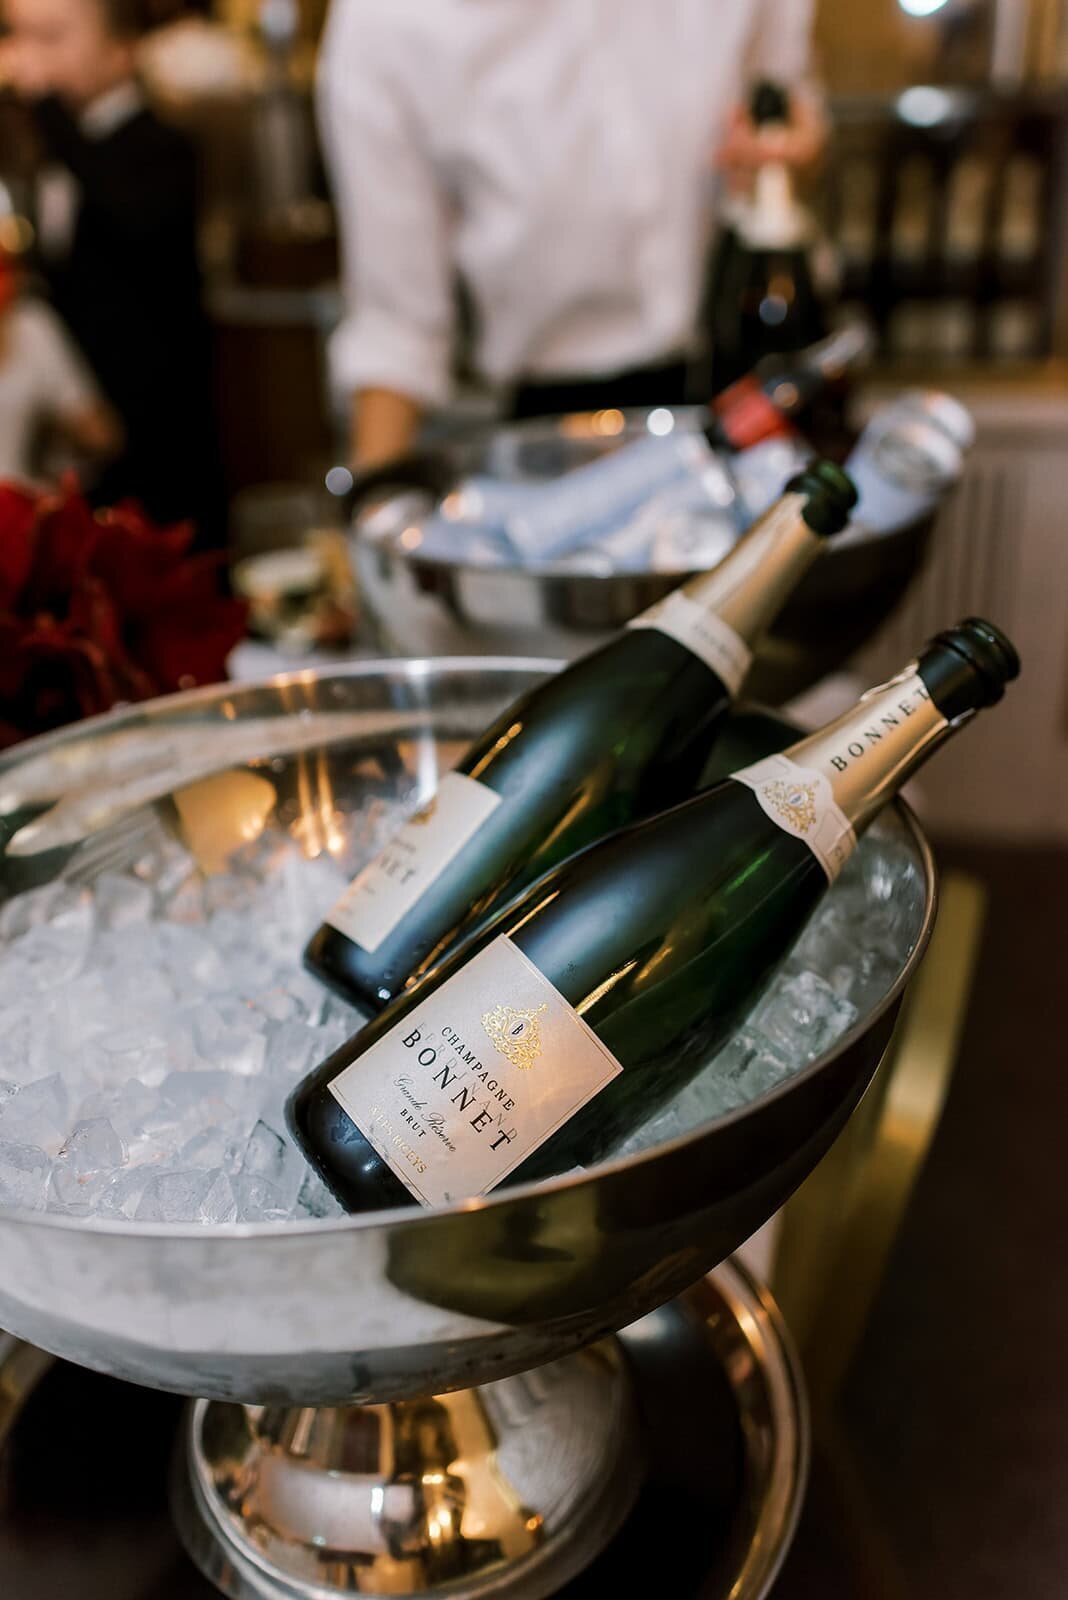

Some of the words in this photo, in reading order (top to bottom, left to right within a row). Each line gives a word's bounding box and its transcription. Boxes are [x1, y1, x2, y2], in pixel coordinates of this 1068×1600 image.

[830, 688, 929, 771] BONNET
[402, 1029, 511, 1151] BONNET
[441, 1026, 515, 1111] CHAMPAGNE
[394, 1073, 427, 1111] Grande
[421, 1112, 457, 1152] Réserve
[400, 1108, 427, 1137] BRUT
